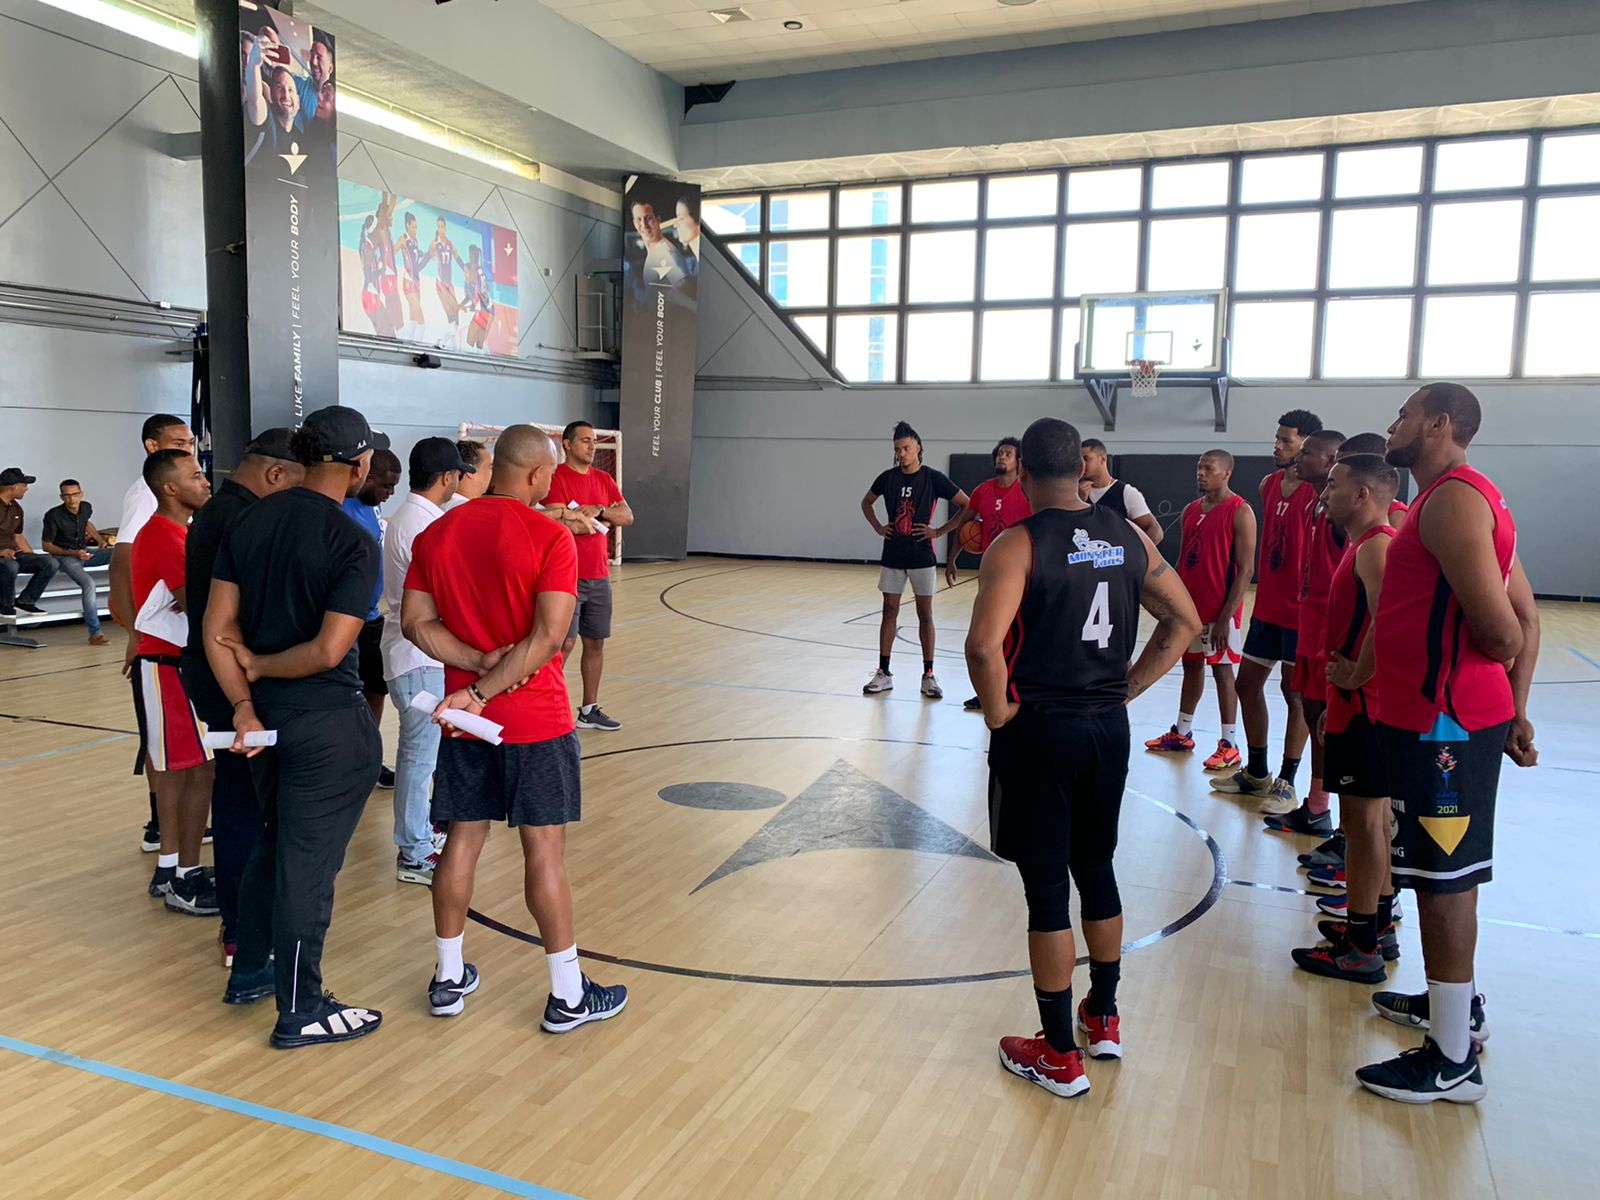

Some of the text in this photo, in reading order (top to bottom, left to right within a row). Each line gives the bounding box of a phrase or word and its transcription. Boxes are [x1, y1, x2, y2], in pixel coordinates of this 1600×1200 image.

[290, 194, 299, 236] BODY
[291, 239, 300, 280] YOUR
[291, 285, 300, 320] FEEL
[657, 291, 665, 319] BODY
[656, 320, 664, 347] YOUR
[293, 330, 302, 382] FAMILY
[655, 349, 664, 373] FEEL
[294, 385, 303, 418] LIKE
[654, 379, 663, 404] CLUB
[653, 405, 661, 432] YOUR
[652, 434, 660, 457] FEEL
[900, 486, 913, 498] 15
[995, 499, 1002, 511] 5
[1196, 513, 1207, 526] 7
[1276, 500, 1290, 517] 17
[1081, 581, 1114, 649] 4
[1437, 804, 1458, 814] 2021
[301, 1008, 379, 1036] AIR
